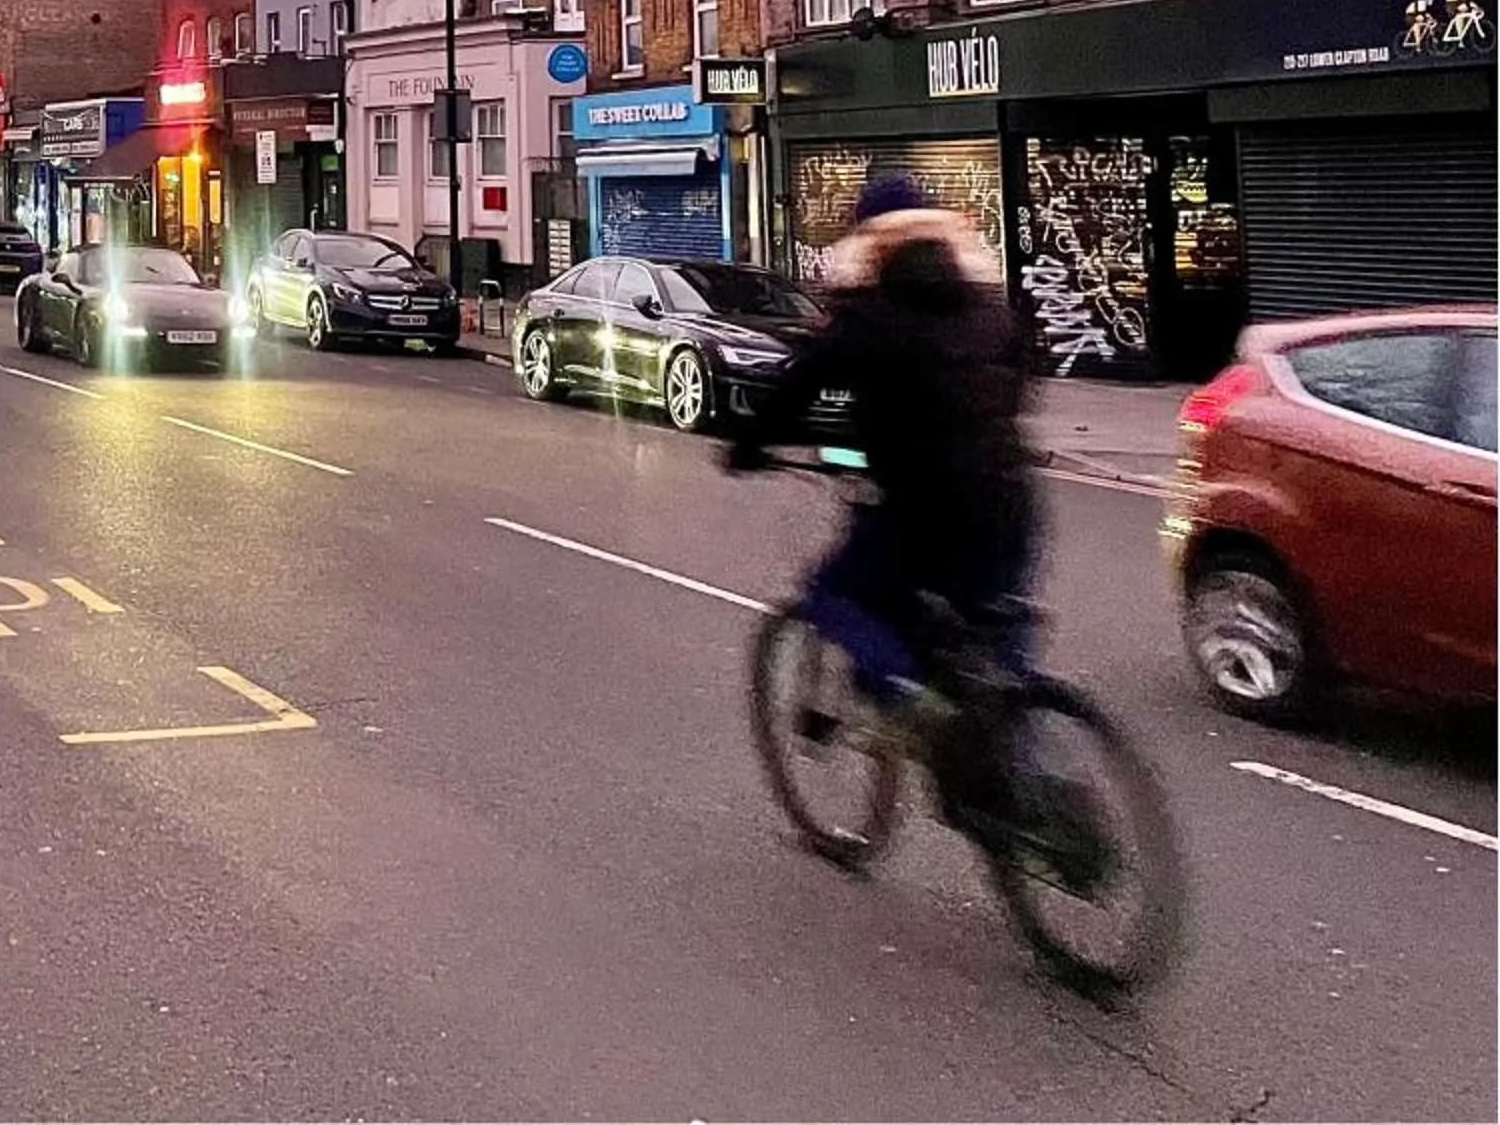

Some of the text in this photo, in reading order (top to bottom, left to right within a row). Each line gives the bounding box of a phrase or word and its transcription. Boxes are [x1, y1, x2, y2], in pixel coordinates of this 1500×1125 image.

[927, 26, 999, 96] HUB VÉLO
[388, 78, 410, 98] THE
